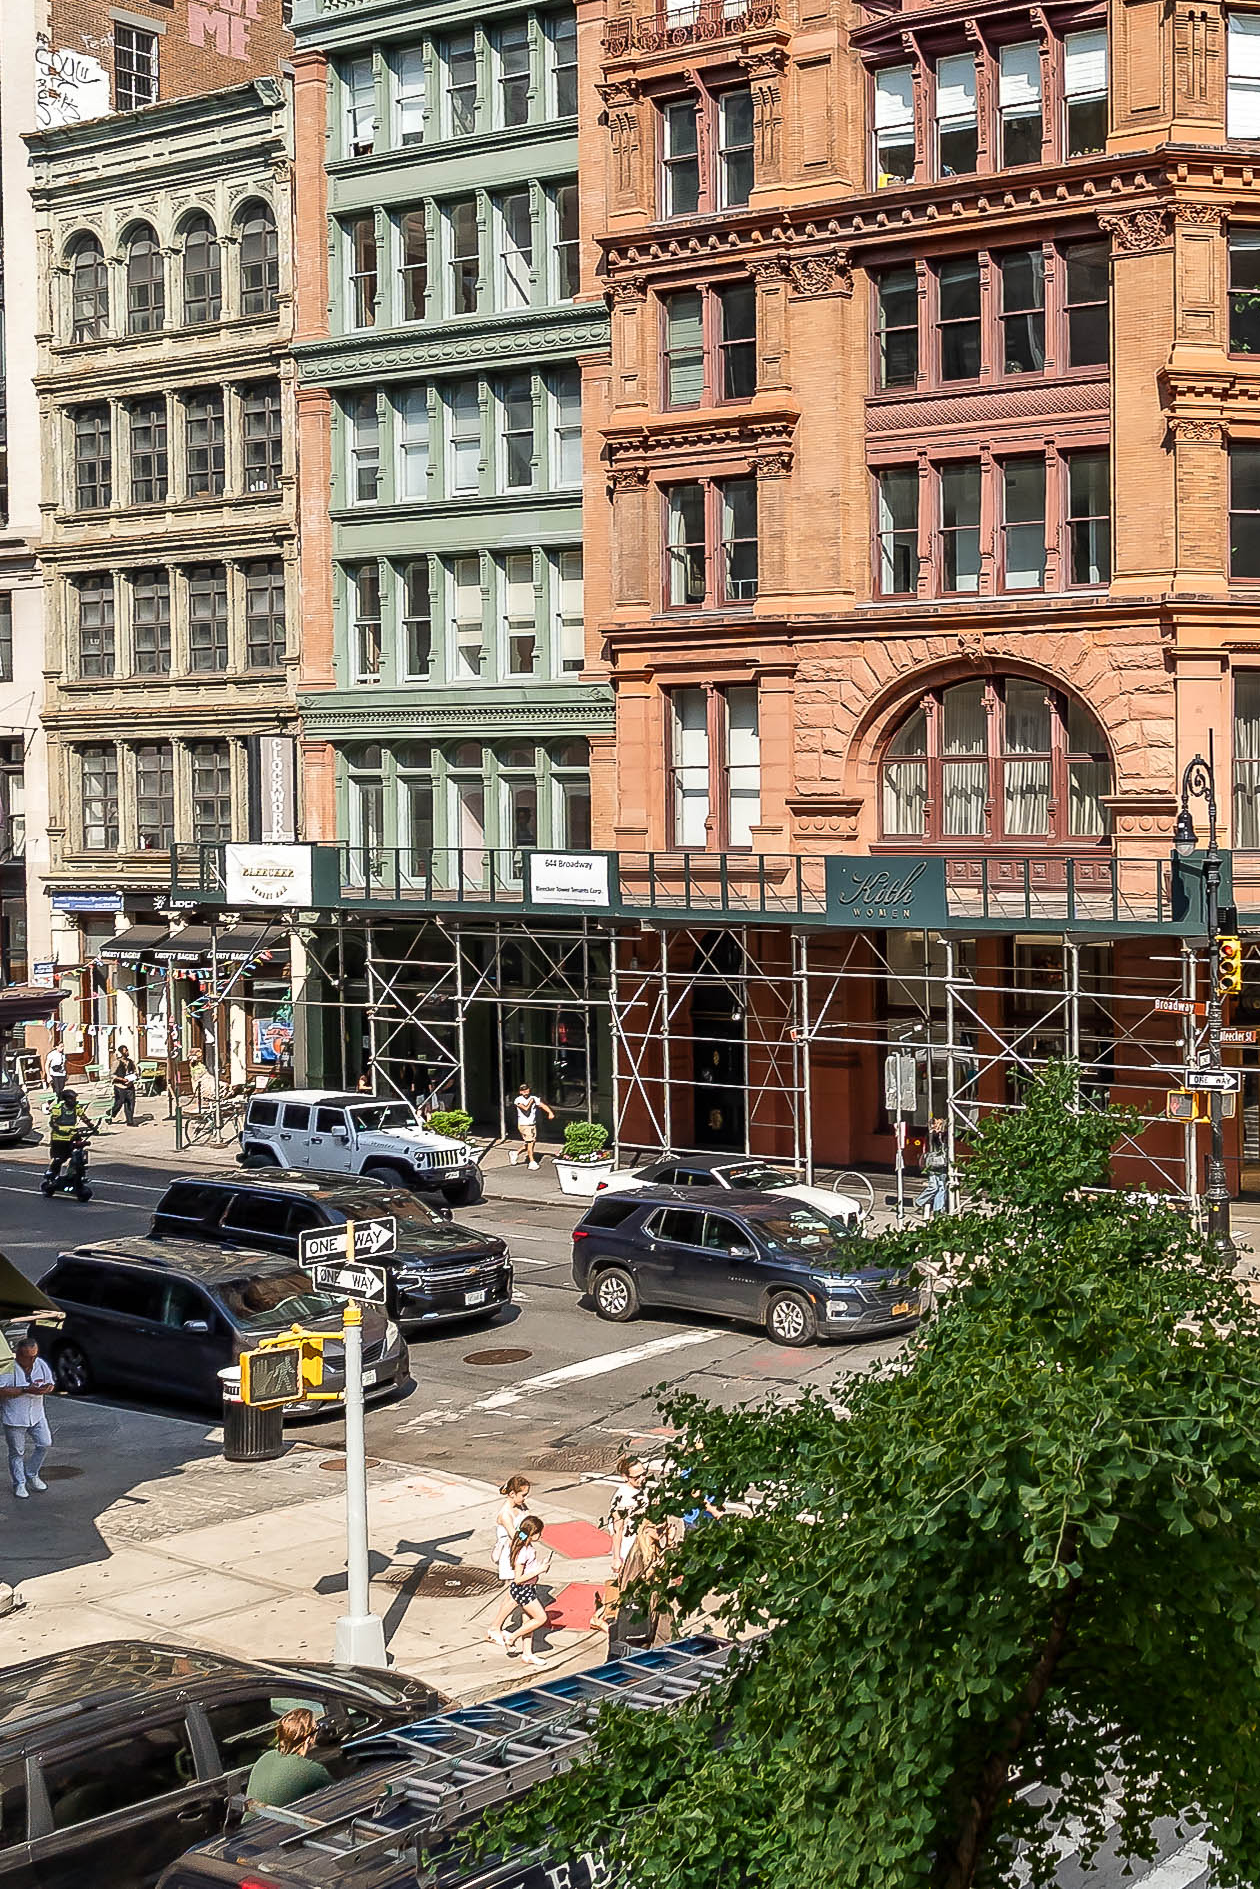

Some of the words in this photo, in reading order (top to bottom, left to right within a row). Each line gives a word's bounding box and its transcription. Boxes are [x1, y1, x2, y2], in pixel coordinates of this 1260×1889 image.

[187, 1, 251, 63] ME
[270, 739, 285, 841] CLOCKWORK
[558, 859, 593, 870] Broadway
[839, 861, 928, 906] Kith
[852, 908, 911, 919] WOMEN
[1154, 998, 1195, 1015] Broadway
[1215, 1077, 1231, 1085] WAY
[309, 1237, 338, 1254] ONE
[355, 1229, 383, 1247] WAY
[320, 1268, 341, 1285] ONE
[352, 1273, 375, 1290] WAY
